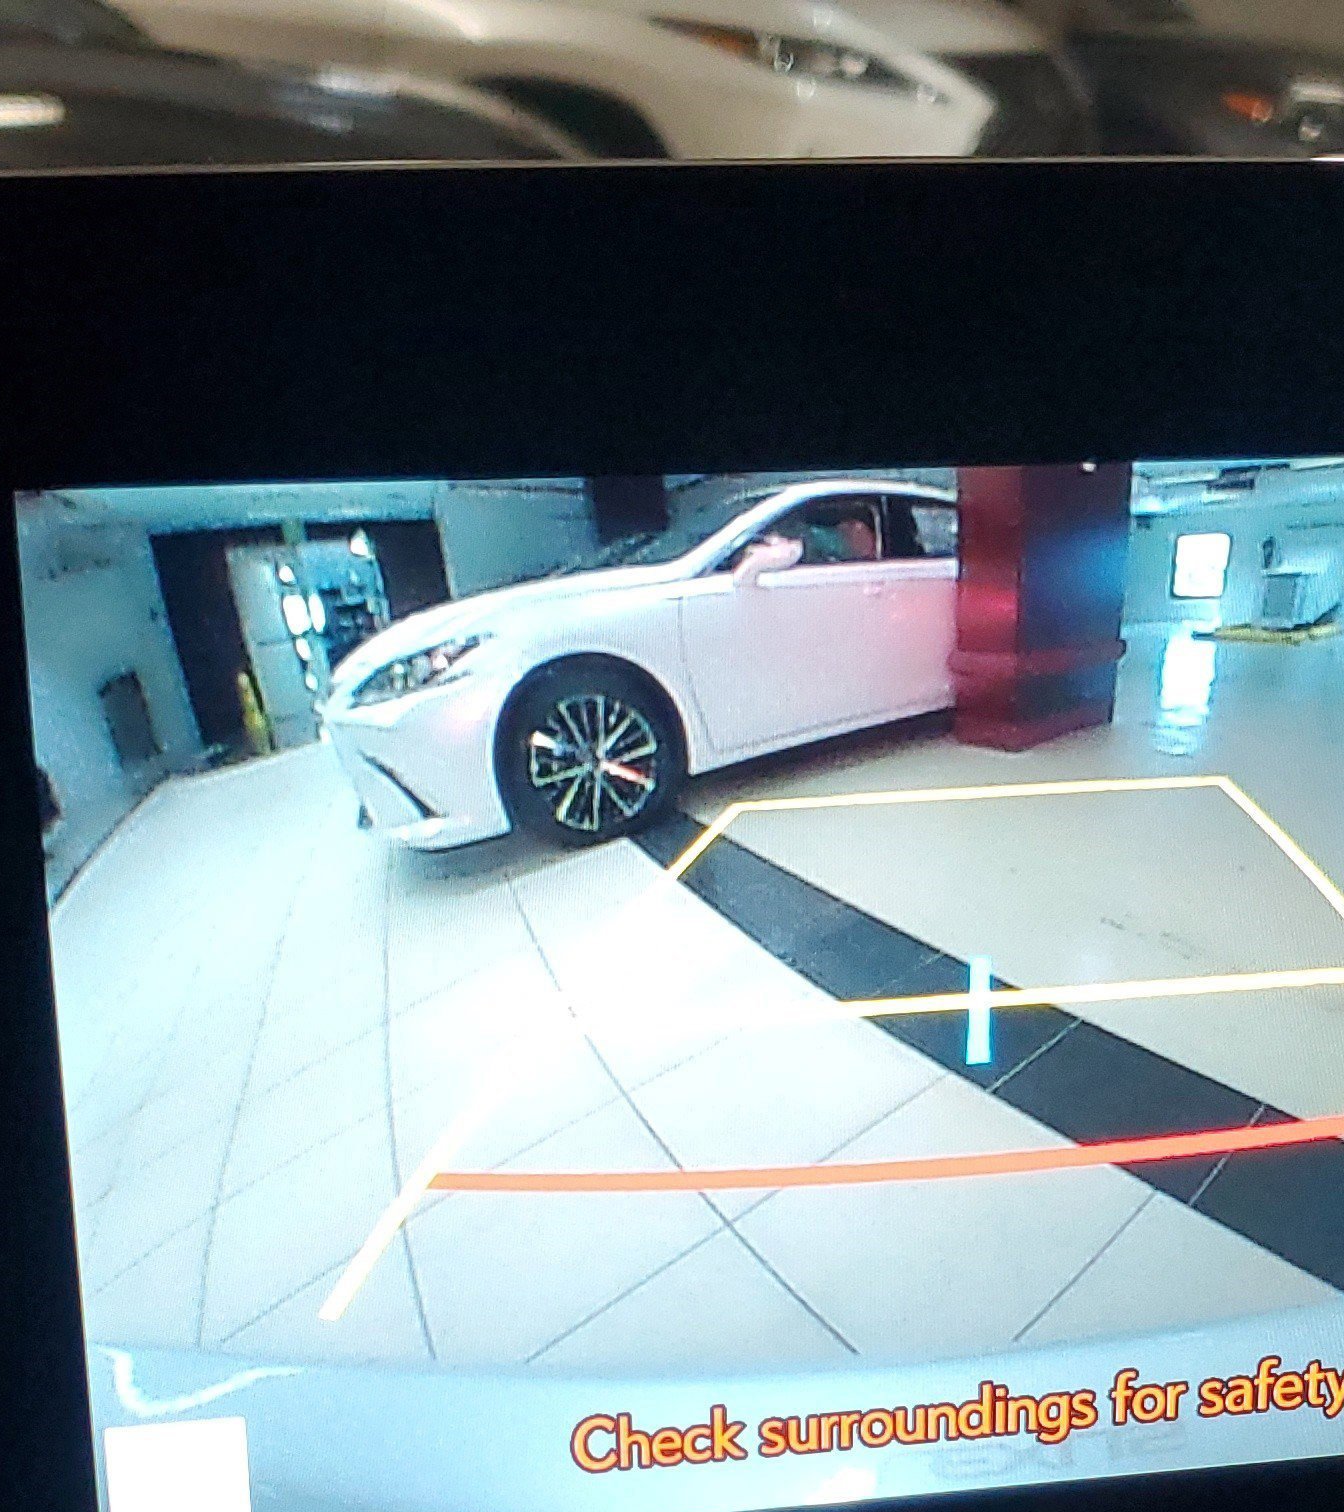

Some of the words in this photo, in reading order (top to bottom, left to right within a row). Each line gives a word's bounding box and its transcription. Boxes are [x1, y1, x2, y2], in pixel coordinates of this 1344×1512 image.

[570, 1405, 749, 1473] Check
[755, 1381, 1098, 1460] surroundings
[1110, 1369, 1188, 1426] for
